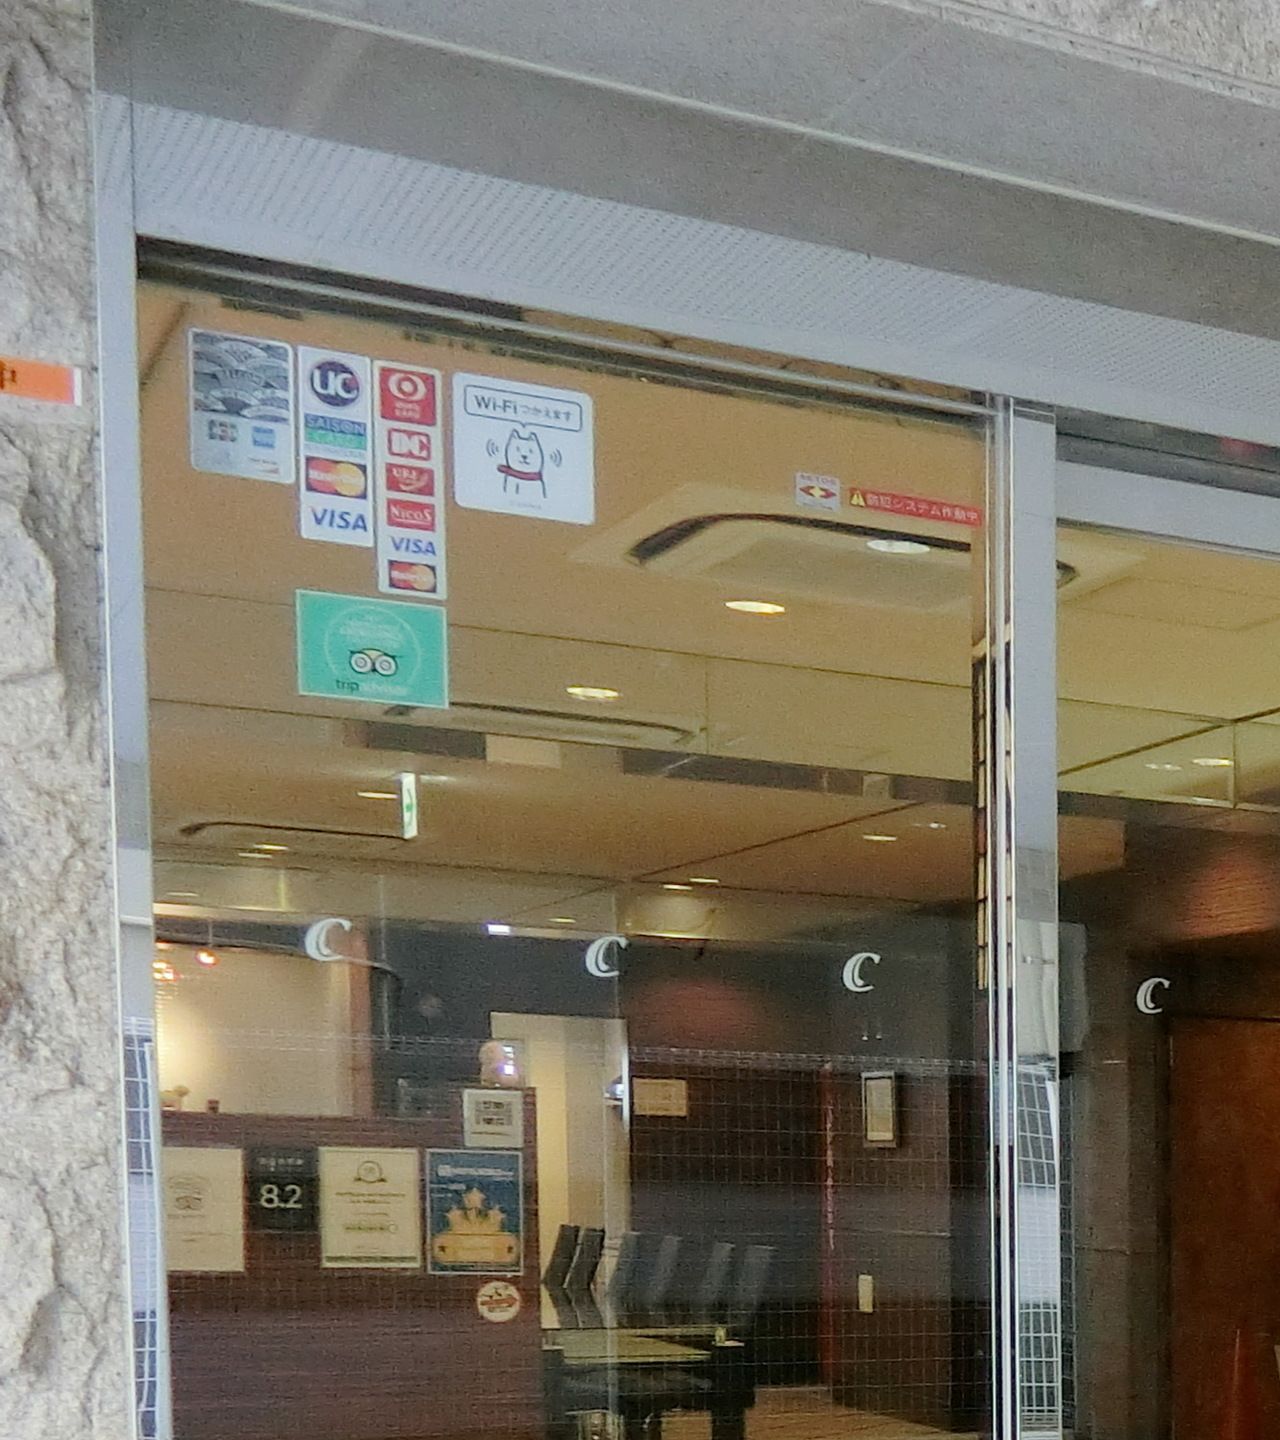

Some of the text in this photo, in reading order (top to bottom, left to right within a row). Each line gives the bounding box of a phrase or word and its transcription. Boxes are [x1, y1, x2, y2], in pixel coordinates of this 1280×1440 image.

[312, 369, 358, 399] UC
[474, 395, 518, 414] Wi-Fi
[306, 414, 365, 435] SAISON
[389, 430, 429, 459] DC
[309, 505, 368, 533] VISA
[389, 535, 437, 557] VISA
[260, 1184, 302, 1208] 8.2
